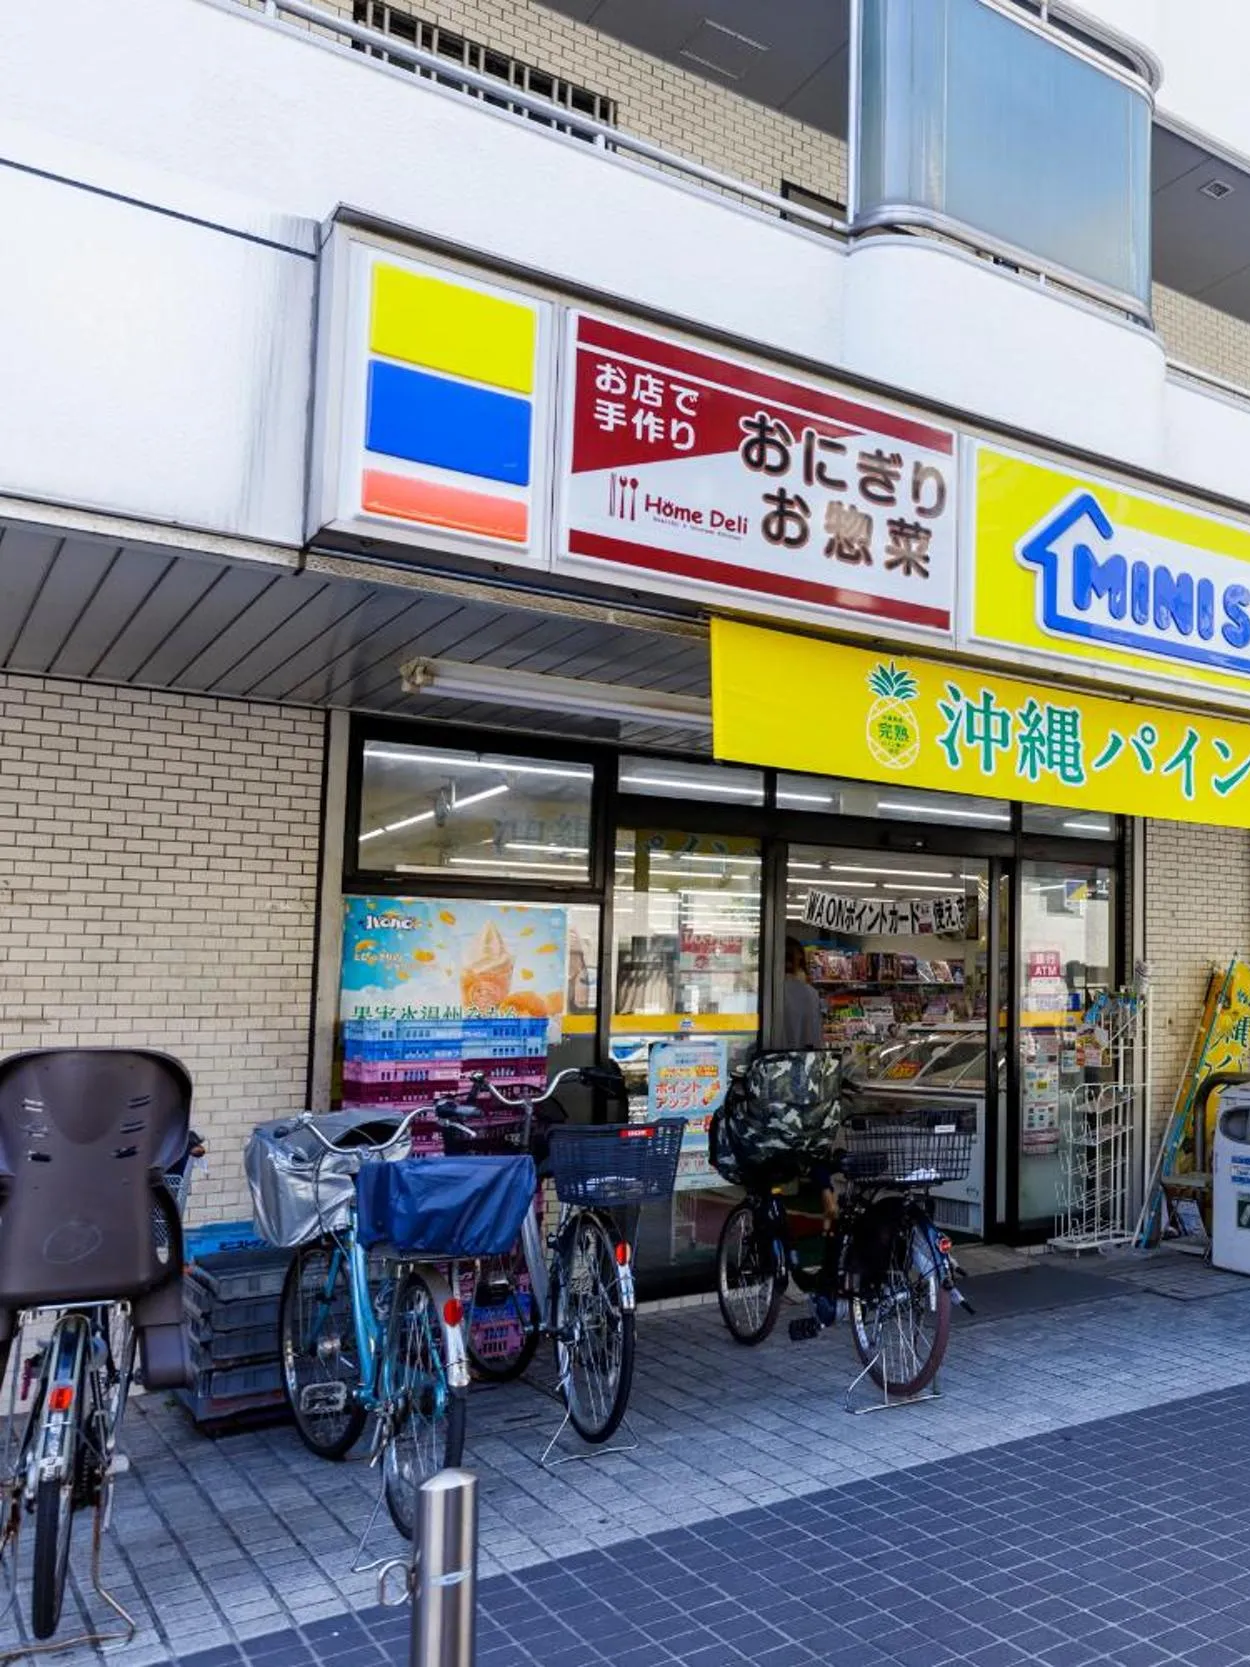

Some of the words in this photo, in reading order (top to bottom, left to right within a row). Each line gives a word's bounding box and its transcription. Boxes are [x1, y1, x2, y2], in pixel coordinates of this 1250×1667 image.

[594, 362, 700, 417] お店で
[593, 397, 697, 451] 手作り
[738, 411, 948, 519] おにぎり
[710, 509, 748, 534] Deli
[760, 486, 934, 579] お惣菜
[1035, 965, 1058, 976] ATM
